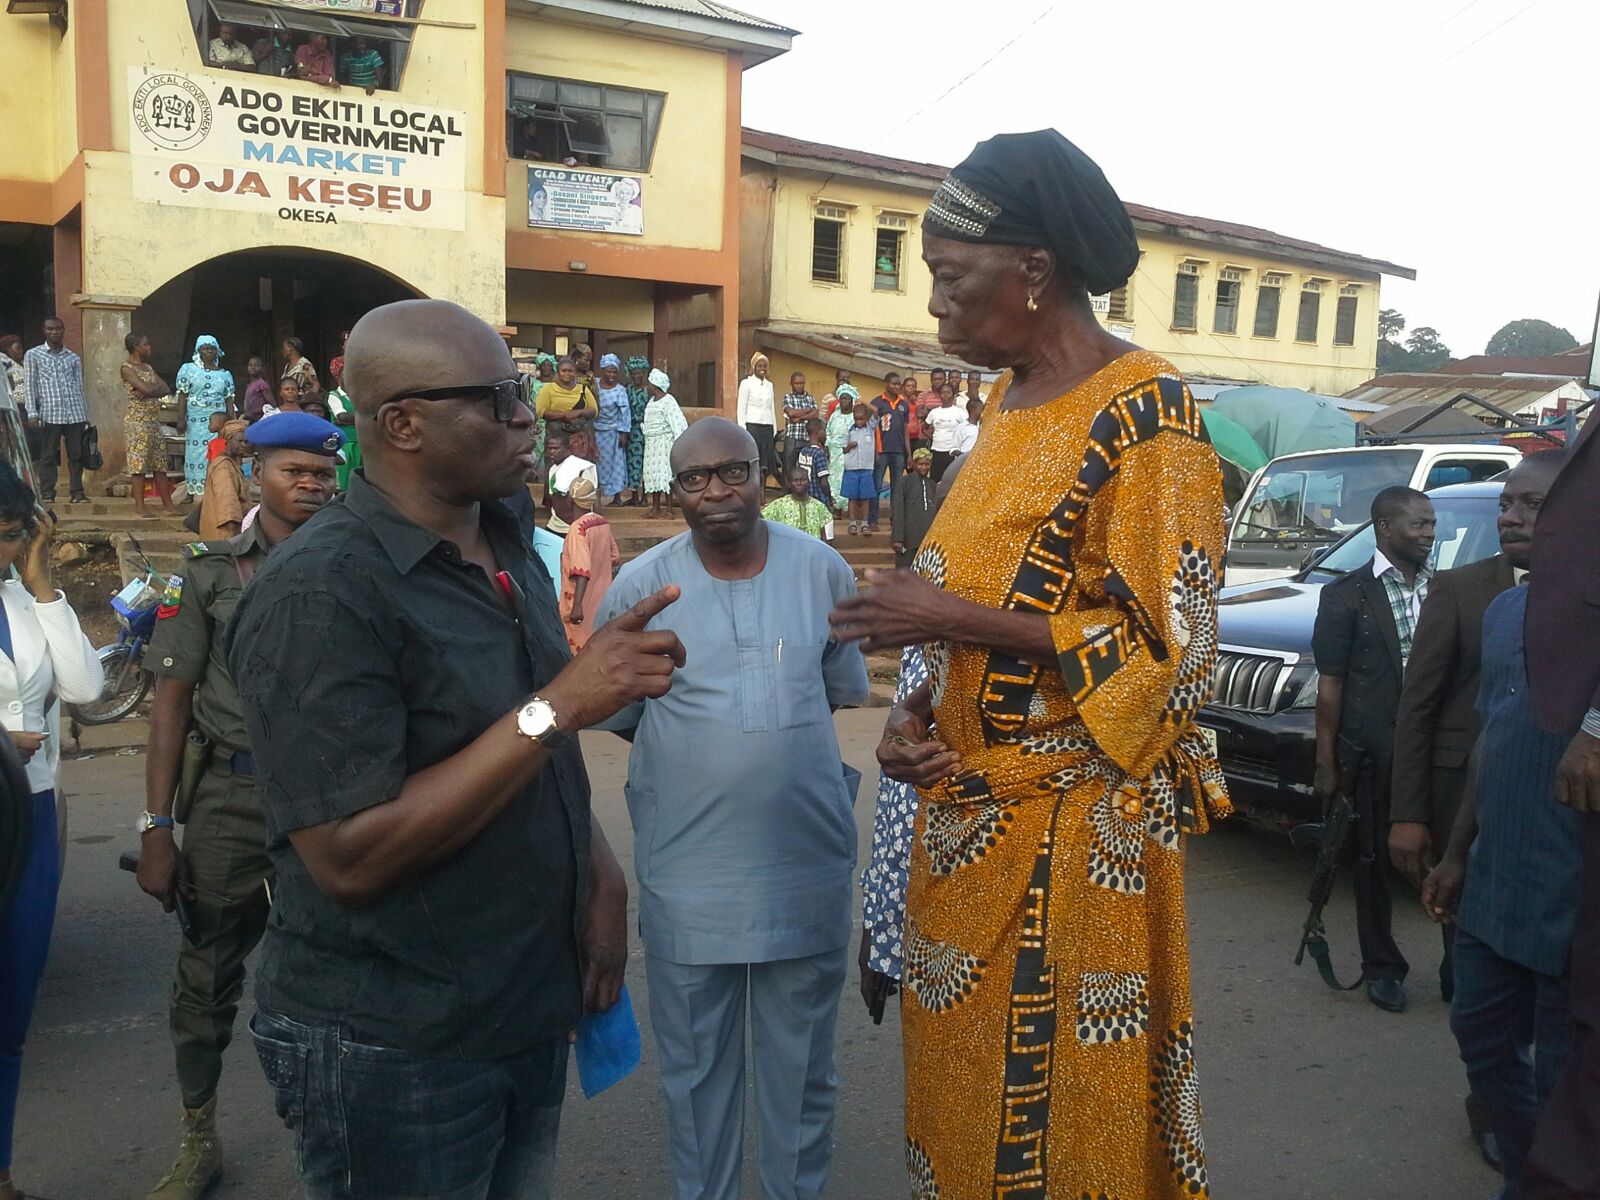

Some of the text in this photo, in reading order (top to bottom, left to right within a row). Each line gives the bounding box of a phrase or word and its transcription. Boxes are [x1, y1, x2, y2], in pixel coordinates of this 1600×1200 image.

[135, 76, 211, 137] ADO EKITI LOCAL GOVERNMENT
[217, 86, 462, 136] ADO EKITI LOCAL
[237, 113, 445, 156] GOVERNMENT
[243, 140, 406, 176] MARKET
[534, 170, 566, 180] GLAD
[570, 173, 614, 185] EVENTS
[278, 207, 337, 224] OKESA
